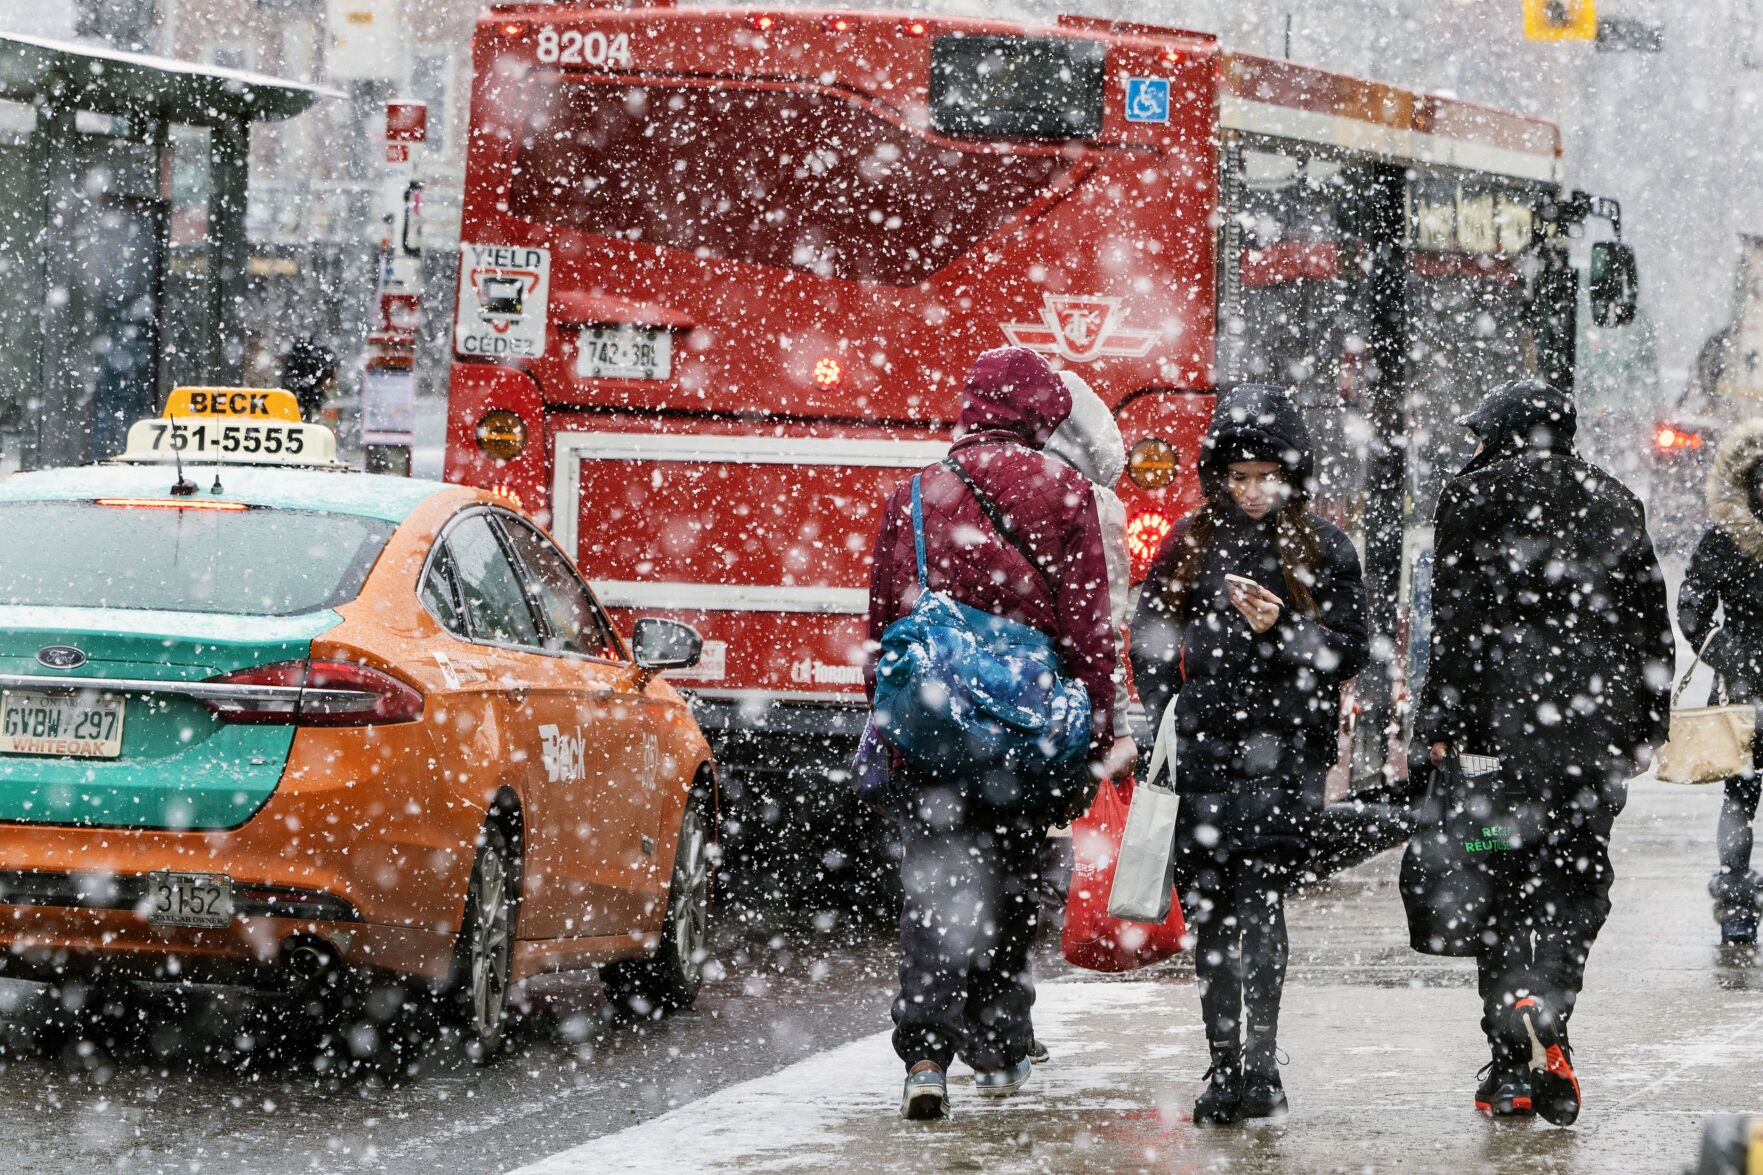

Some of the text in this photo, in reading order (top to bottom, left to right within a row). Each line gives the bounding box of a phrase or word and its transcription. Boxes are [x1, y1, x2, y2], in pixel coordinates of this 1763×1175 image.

[536, 31, 632, 67] 8204
[471, 247, 541, 270] YIELD
[190, 392, 270, 416] BECK
[150, 424, 305, 455] 751-5555
[74, 710, 117, 741] 297
[12, 738, 105, 756] WHITEOAK
[157, 885, 222, 916] 3152
